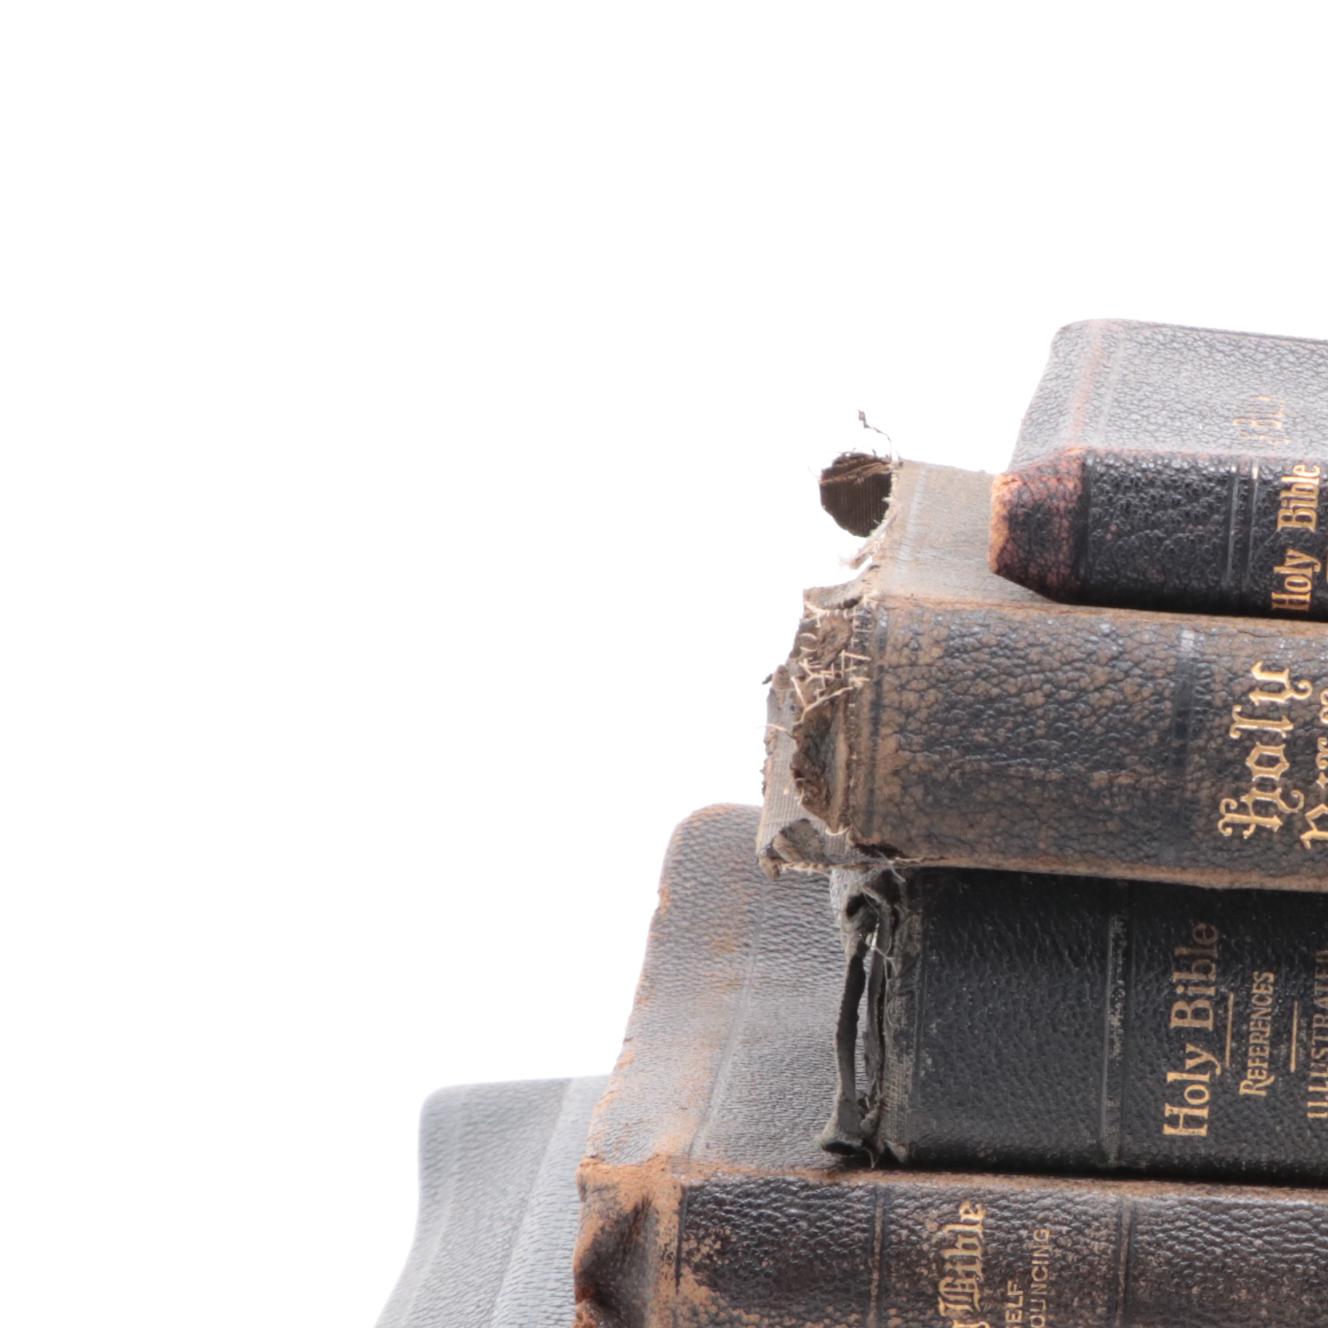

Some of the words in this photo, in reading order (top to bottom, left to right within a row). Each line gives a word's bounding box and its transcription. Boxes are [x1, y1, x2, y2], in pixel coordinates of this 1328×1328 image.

[1276, 463, 1321, 532] Bible
[1271, 548, 1321, 611] Holy
[1218, 660, 1313, 840] Holy
[1169, 921, 1219, 1032] Bible
[1162, 1043, 1222, 1137] Holy
[937, 1200, 988, 1317] Bible
